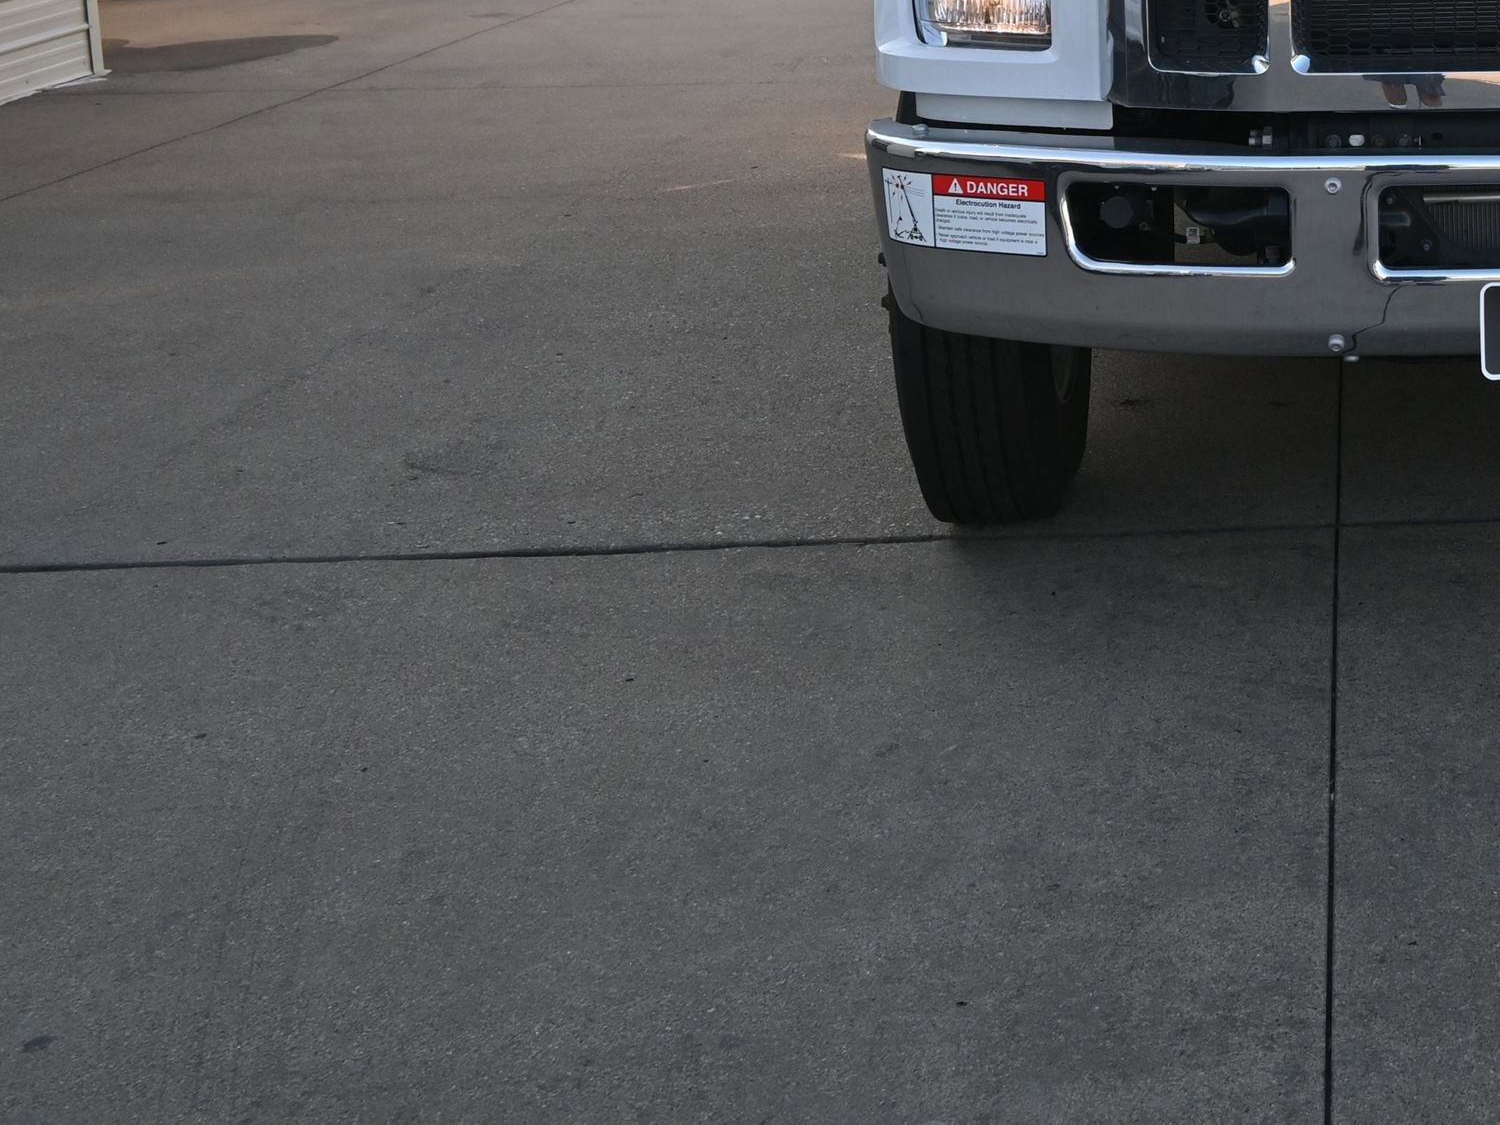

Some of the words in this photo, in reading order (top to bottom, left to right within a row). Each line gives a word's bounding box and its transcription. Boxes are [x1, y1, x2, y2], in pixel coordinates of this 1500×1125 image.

[966, 181, 1028, 197] DANGER
[955, 199, 997, 208] Electrocution
[998, 202, 1021, 210] Hazard
